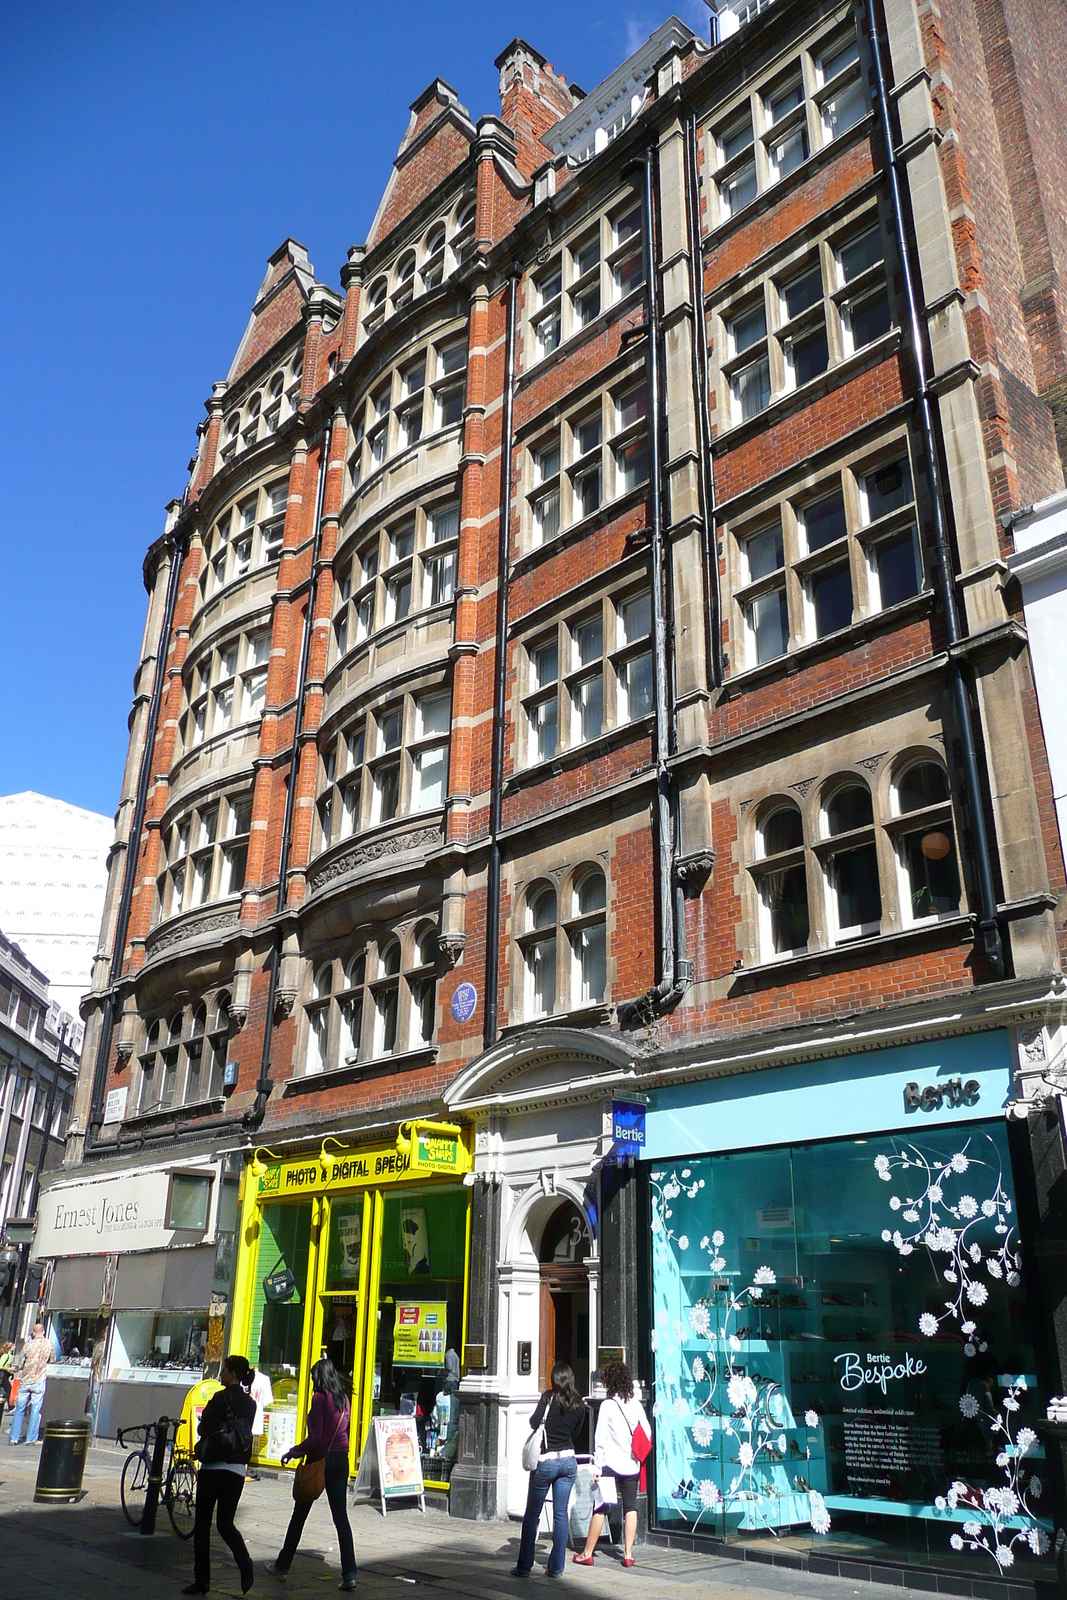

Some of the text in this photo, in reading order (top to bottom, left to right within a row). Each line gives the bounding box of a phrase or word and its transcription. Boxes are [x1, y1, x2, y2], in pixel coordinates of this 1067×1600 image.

[904, 1077, 980, 1111] Bertie
[615, 1125, 644, 1142] Bertie
[423, 1137, 455, 1151] SNAPPY
[427, 1148, 454, 1162] SNAPS
[286, 1167, 316, 1187] PHOTO
[320, 1170, 327, 1182] &
[332, 1160, 369, 1181] DIGITAL
[54, 1197, 140, 1235] Ernest Jones
[104, 1224, 113, 1232] THE
[570, 1216, 591, 1246] 34
[866, 1353, 891, 1363] Bertie
[833, 1352, 928, 1395] Bespoke
[843, 1406, 857, 1414] limited
